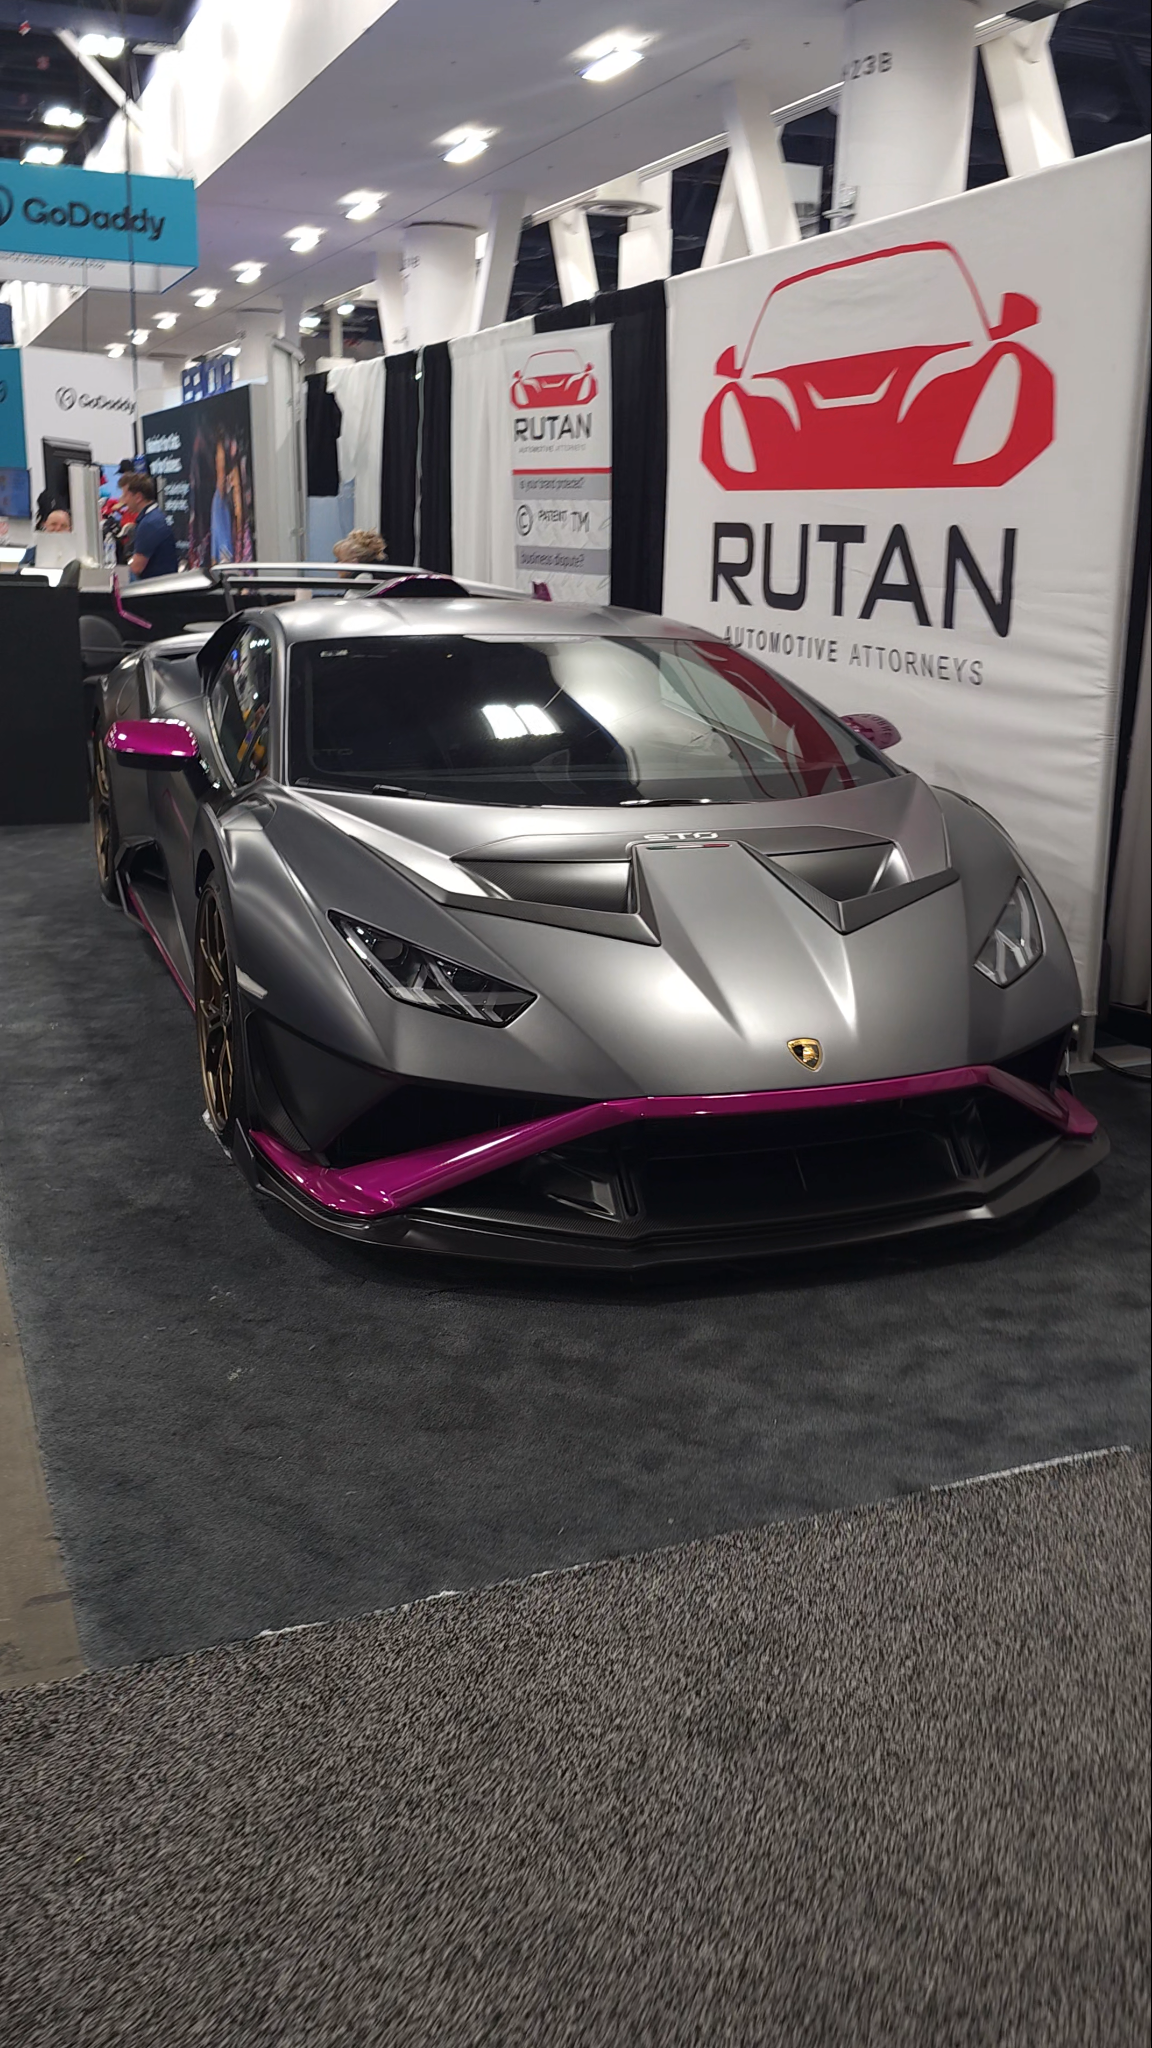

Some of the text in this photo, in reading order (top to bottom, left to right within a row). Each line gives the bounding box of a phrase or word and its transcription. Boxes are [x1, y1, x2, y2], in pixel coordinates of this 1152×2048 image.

[22, 197, 166, 241] GoDaddy
[514, 413, 592, 442] RUTAN
[538, 509, 568, 522] PATENT
[570, 511, 590, 533] TM
[710, 522, 1018, 638] RUTAN
[722, 625, 984, 686] AUTOMOTIVE ATTORNEYS
[643, 831, 719, 841] STO
